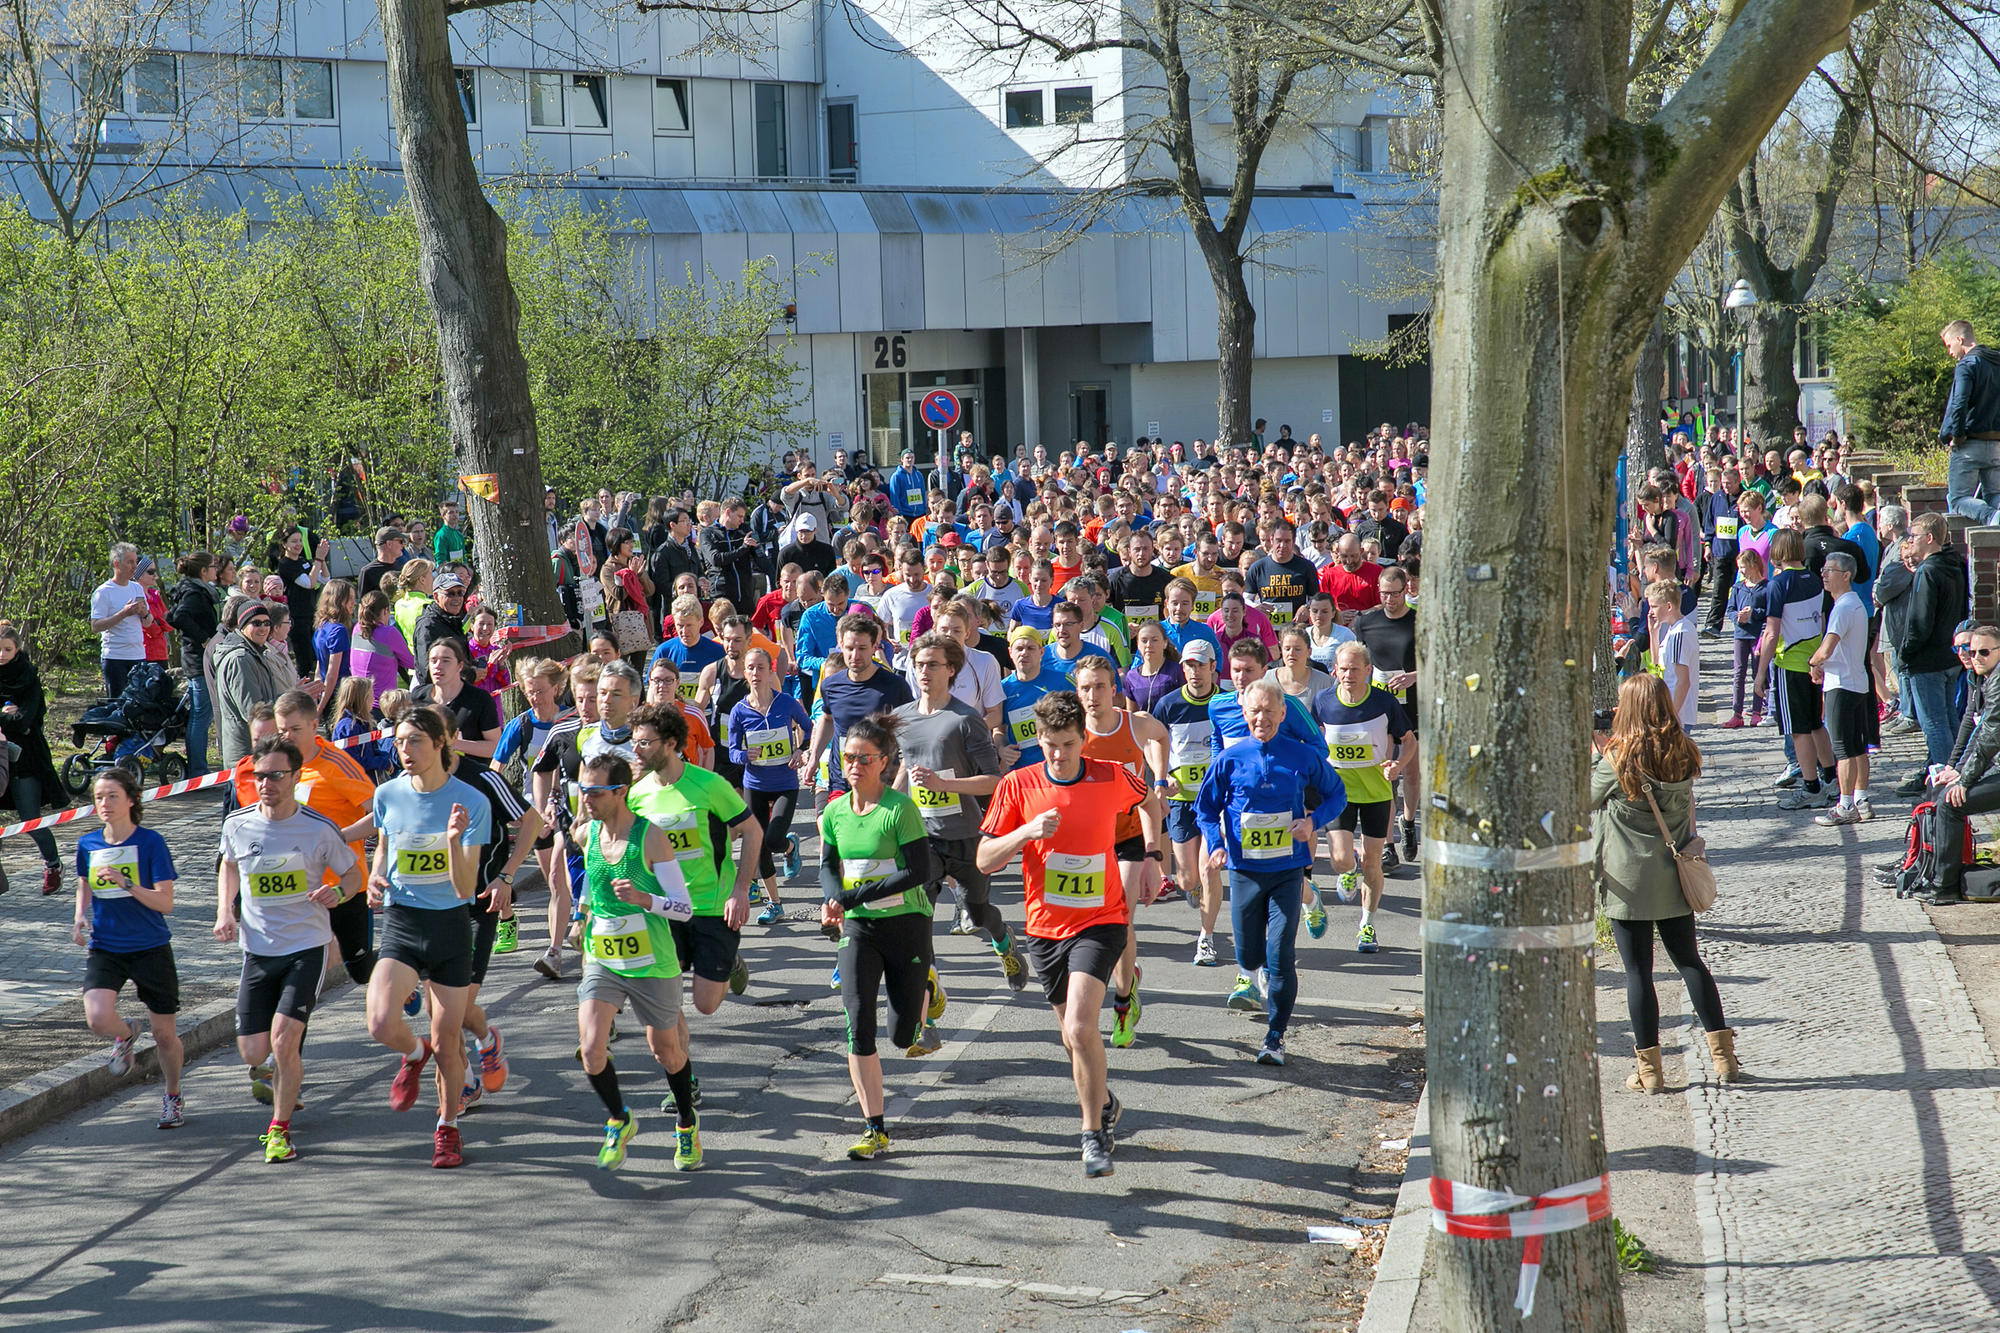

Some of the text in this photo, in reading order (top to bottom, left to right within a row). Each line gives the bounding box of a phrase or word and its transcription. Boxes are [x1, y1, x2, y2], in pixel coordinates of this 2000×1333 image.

[874, 335, 906, 369] 26
[1719, 525, 1733, 534] 245
[1269, 574, 1292, 586] BEAT
[1261, 585, 1304, 598] STANFORD
[1336, 747, 1366, 759] 892
[919, 790, 949, 805] 524
[1250, 829, 1283, 847] 817
[407, 853, 446, 871] 728
[258, 874, 297, 894] 884
[1056, 874, 1095, 895] 711
[673, 901, 692, 915] asics
[603, 936, 640, 956] 879
